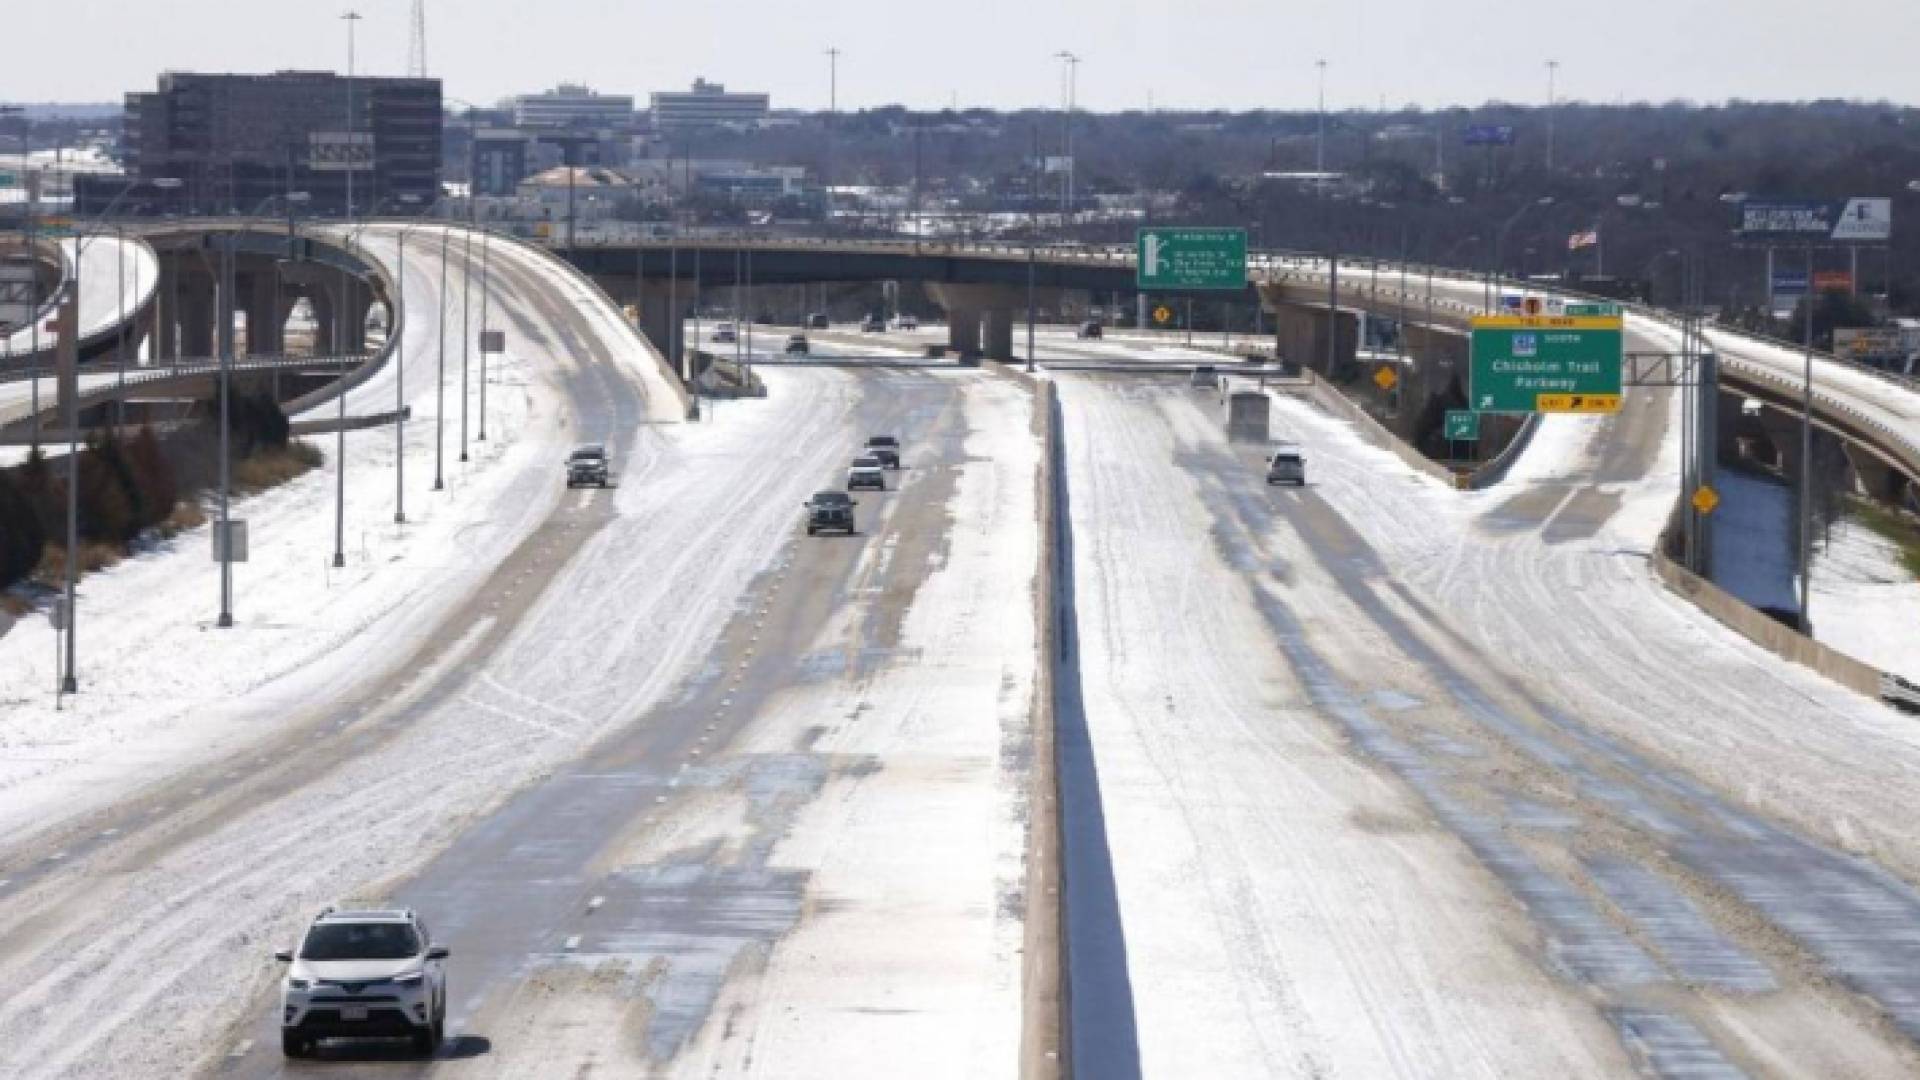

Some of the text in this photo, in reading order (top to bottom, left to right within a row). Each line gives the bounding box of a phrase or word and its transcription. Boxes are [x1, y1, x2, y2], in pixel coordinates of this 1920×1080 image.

[1544, 334, 1581, 343] SOUTH
[1492, 360, 1600, 373] Chisholm Trail
[1515, 376, 1577, 391] Parkway
